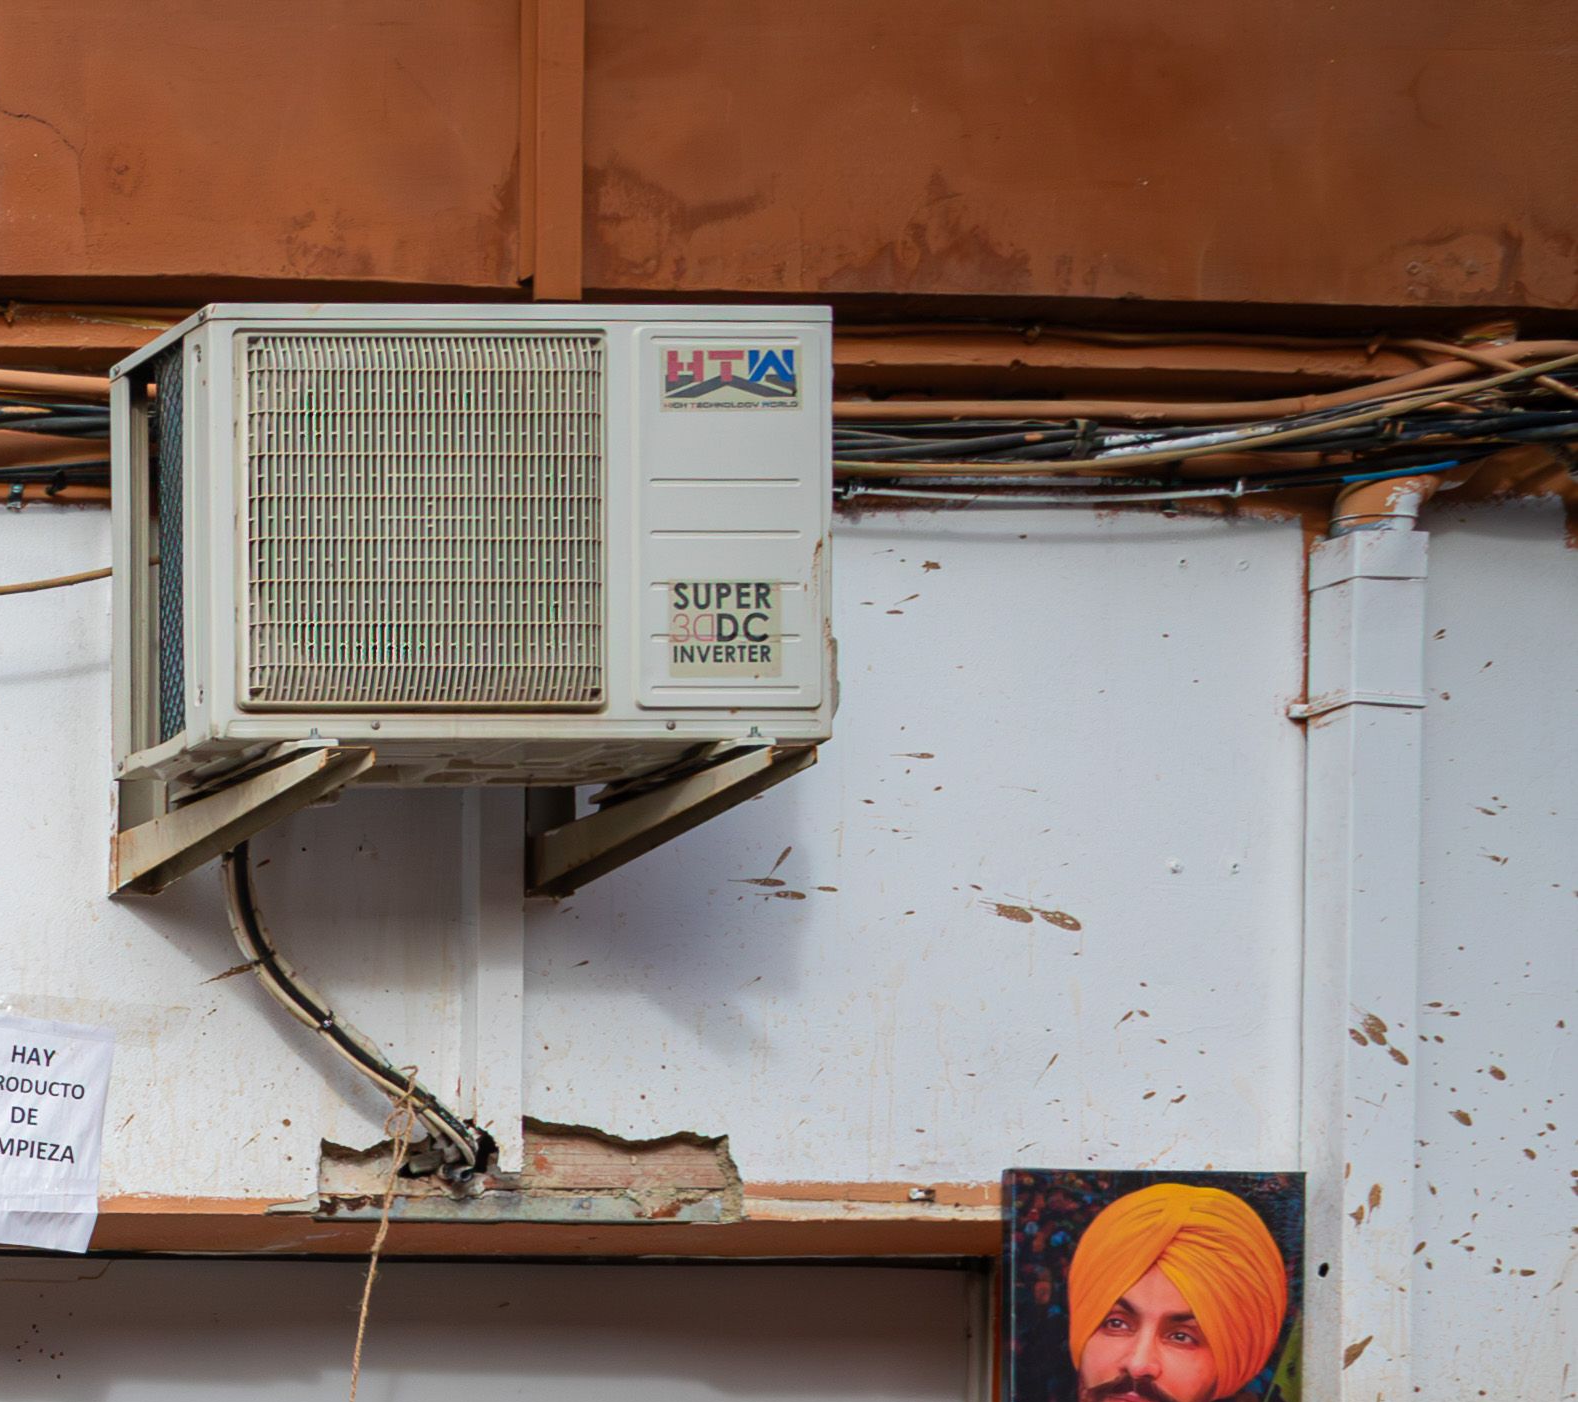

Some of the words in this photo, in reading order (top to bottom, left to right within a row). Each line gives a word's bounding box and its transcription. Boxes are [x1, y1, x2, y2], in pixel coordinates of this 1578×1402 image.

[673, 583, 772, 609] SUPER
[672, 644, 772, 663] INVERTER
[11, 1045, 56, 1067] HAY
[11, 1106, 38, 1125] DE
